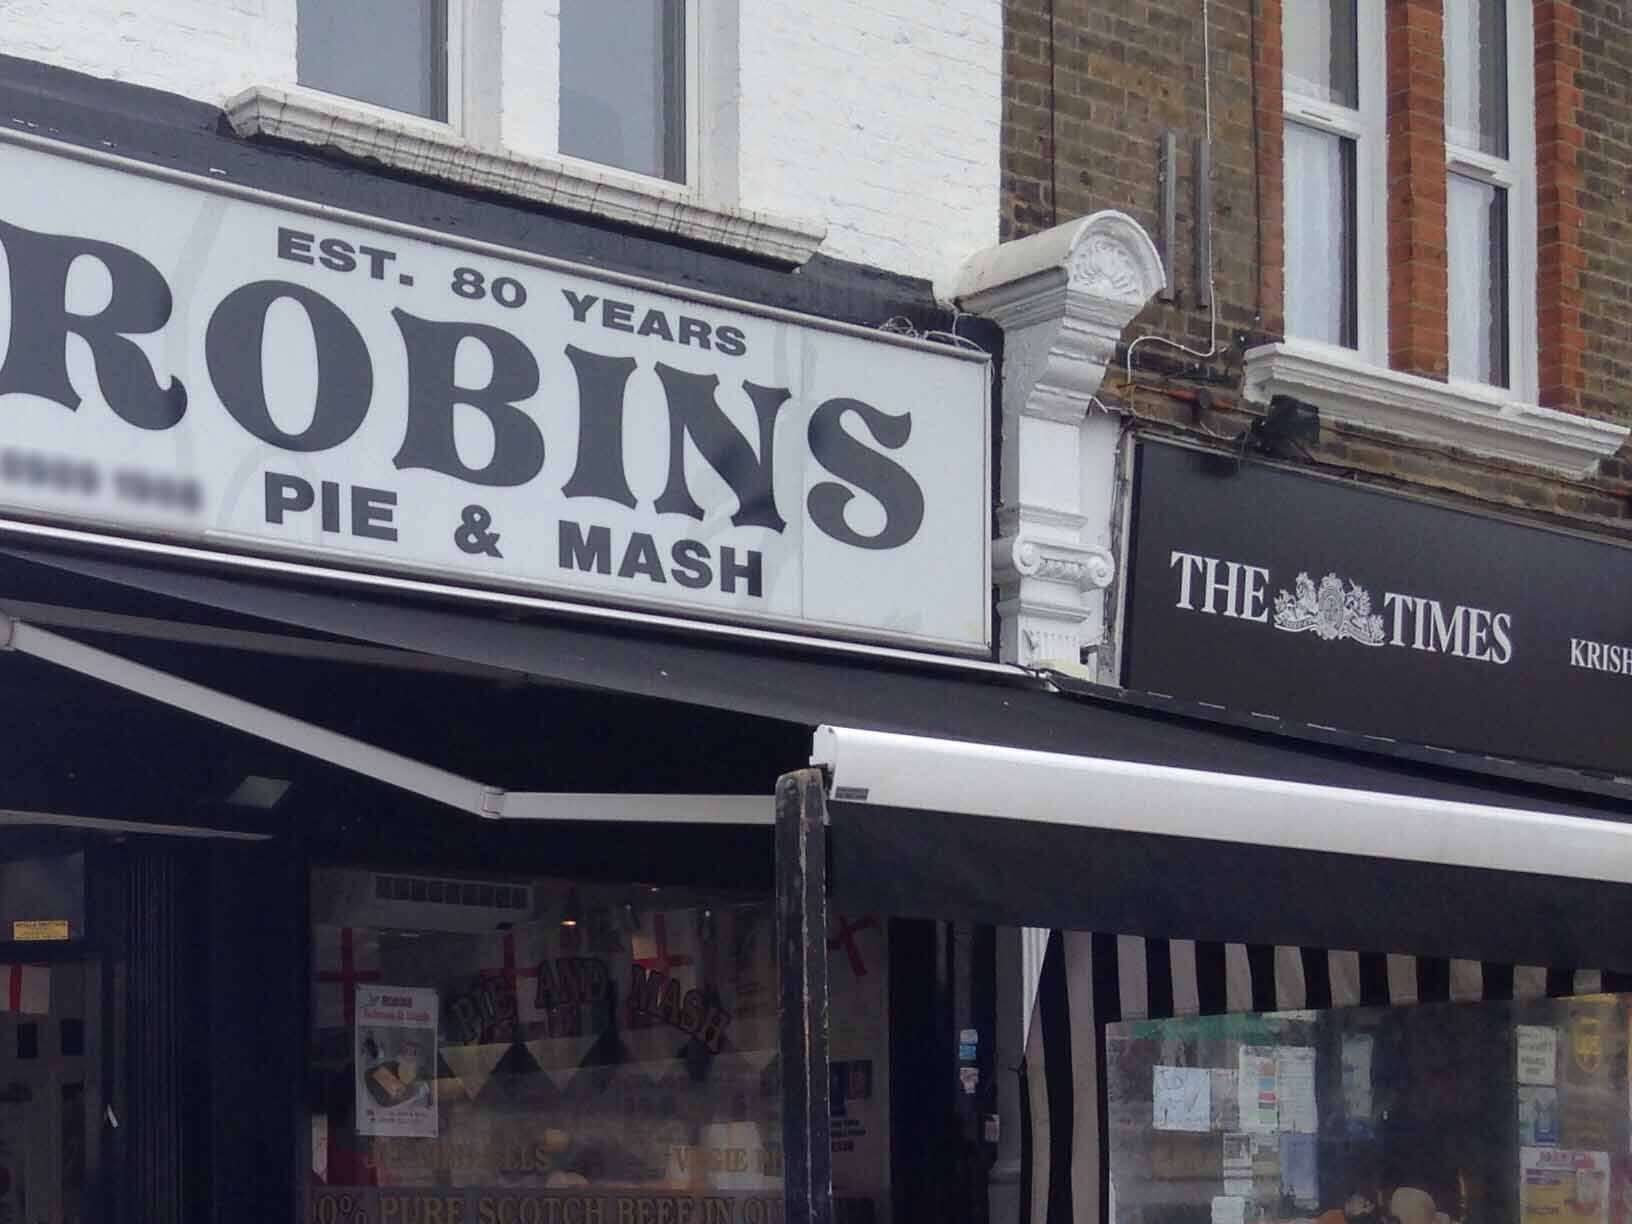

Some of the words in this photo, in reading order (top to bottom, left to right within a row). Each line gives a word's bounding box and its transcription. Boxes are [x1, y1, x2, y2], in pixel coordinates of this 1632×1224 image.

[277, 226, 413, 287] EST.
[451, 267, 528, 309] 80
[561, 287, 748, 357] YEARS
[264, 471, 399, 543] PIE
[453, 504, 504, 560] &
[558, 519, 764, 599] MASH
[1170, 550, 1269, 624] THE
[1384, 591, 1512, 665] TIMES
[449, 976, 517, 1042] PIE
[535, 957, 608, 1009] AND
[628, 964, 731, 1055] MASH
